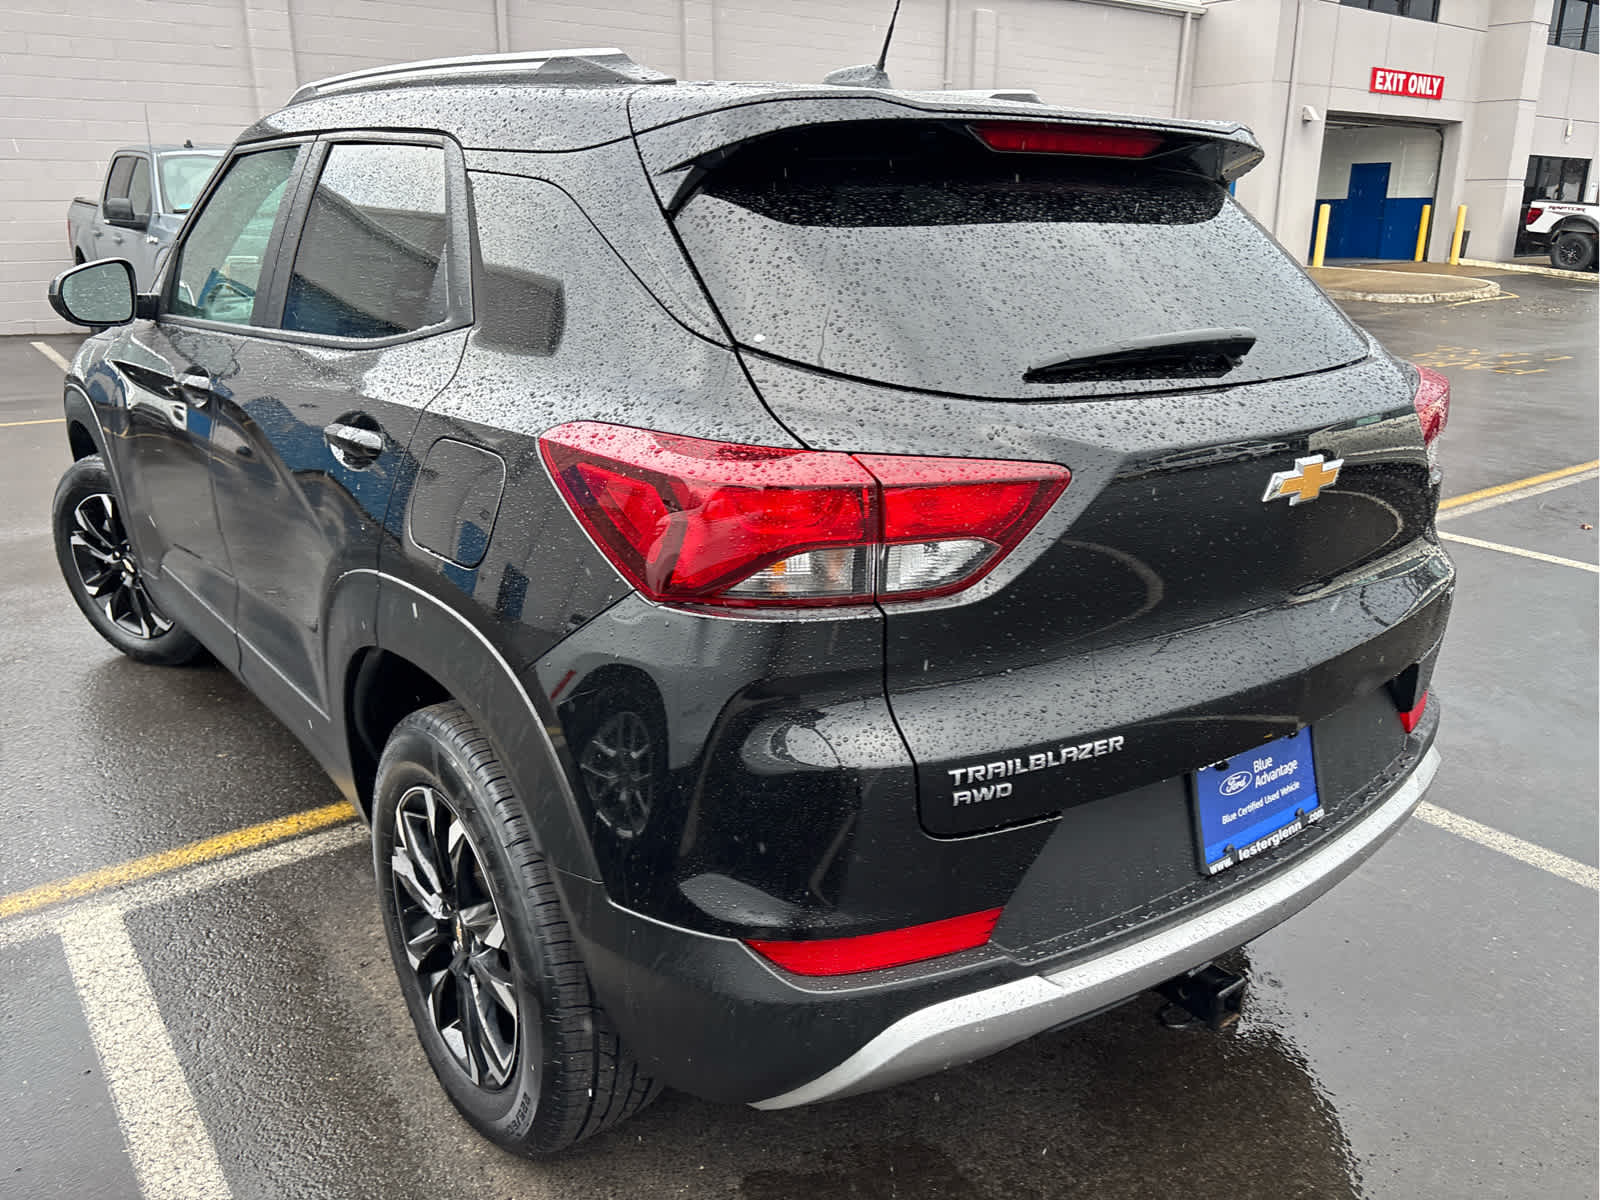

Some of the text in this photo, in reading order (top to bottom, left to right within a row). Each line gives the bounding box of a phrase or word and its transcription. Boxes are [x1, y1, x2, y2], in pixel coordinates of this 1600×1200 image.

[1374, 70, 1442, 96] EXIT ONLY
[948, 735, 1125, 786] TRAILBLAZER
[1253, 757, 1273, 774] Blue
[1255, 760, 1299, 788] Advantage
[952, 782, 1013, 807] AWD
[1225, 774, 1247, 793] Ford
[1222, 781, 1300, 825] Blue Certified Used Vehicle
[1238, 821, 1302, 861] lesterglenn
